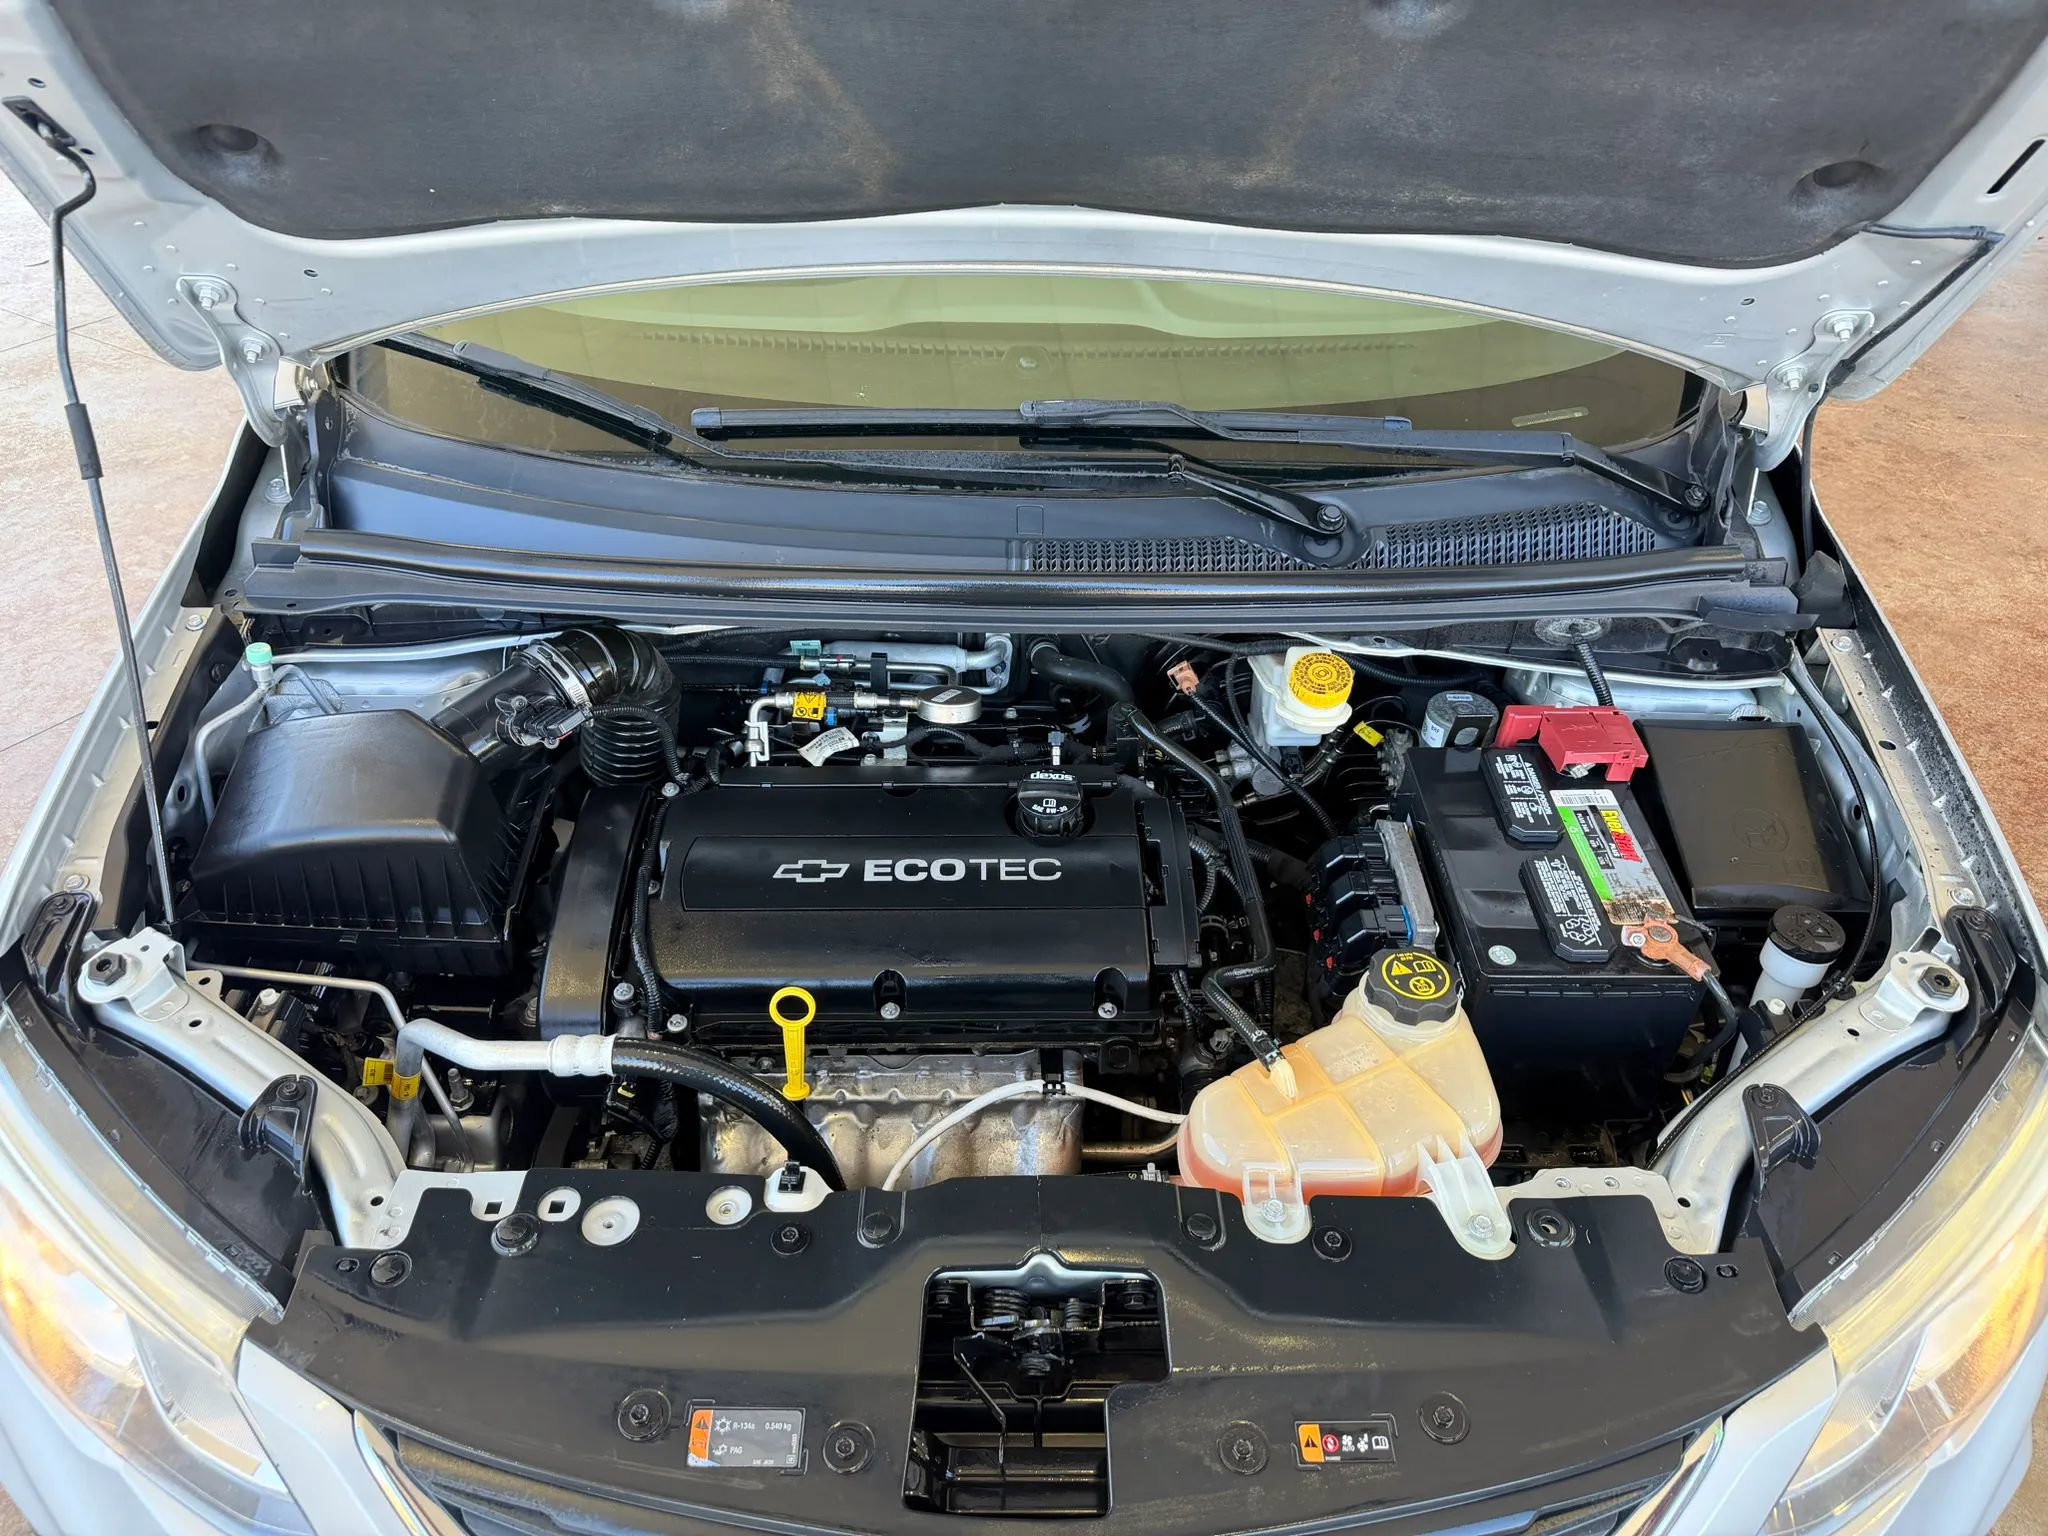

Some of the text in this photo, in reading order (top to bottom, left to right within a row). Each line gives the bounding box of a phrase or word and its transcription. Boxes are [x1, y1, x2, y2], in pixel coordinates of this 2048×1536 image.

[1030, 770, 1073, 781] dexos
[1609, 842, 1621, 857] PLUS
[863, 858, 1063, 882] ECOTEC
[783, 1421, 792, 1432] kg
[729, 1446, 743, 1455] PAG
